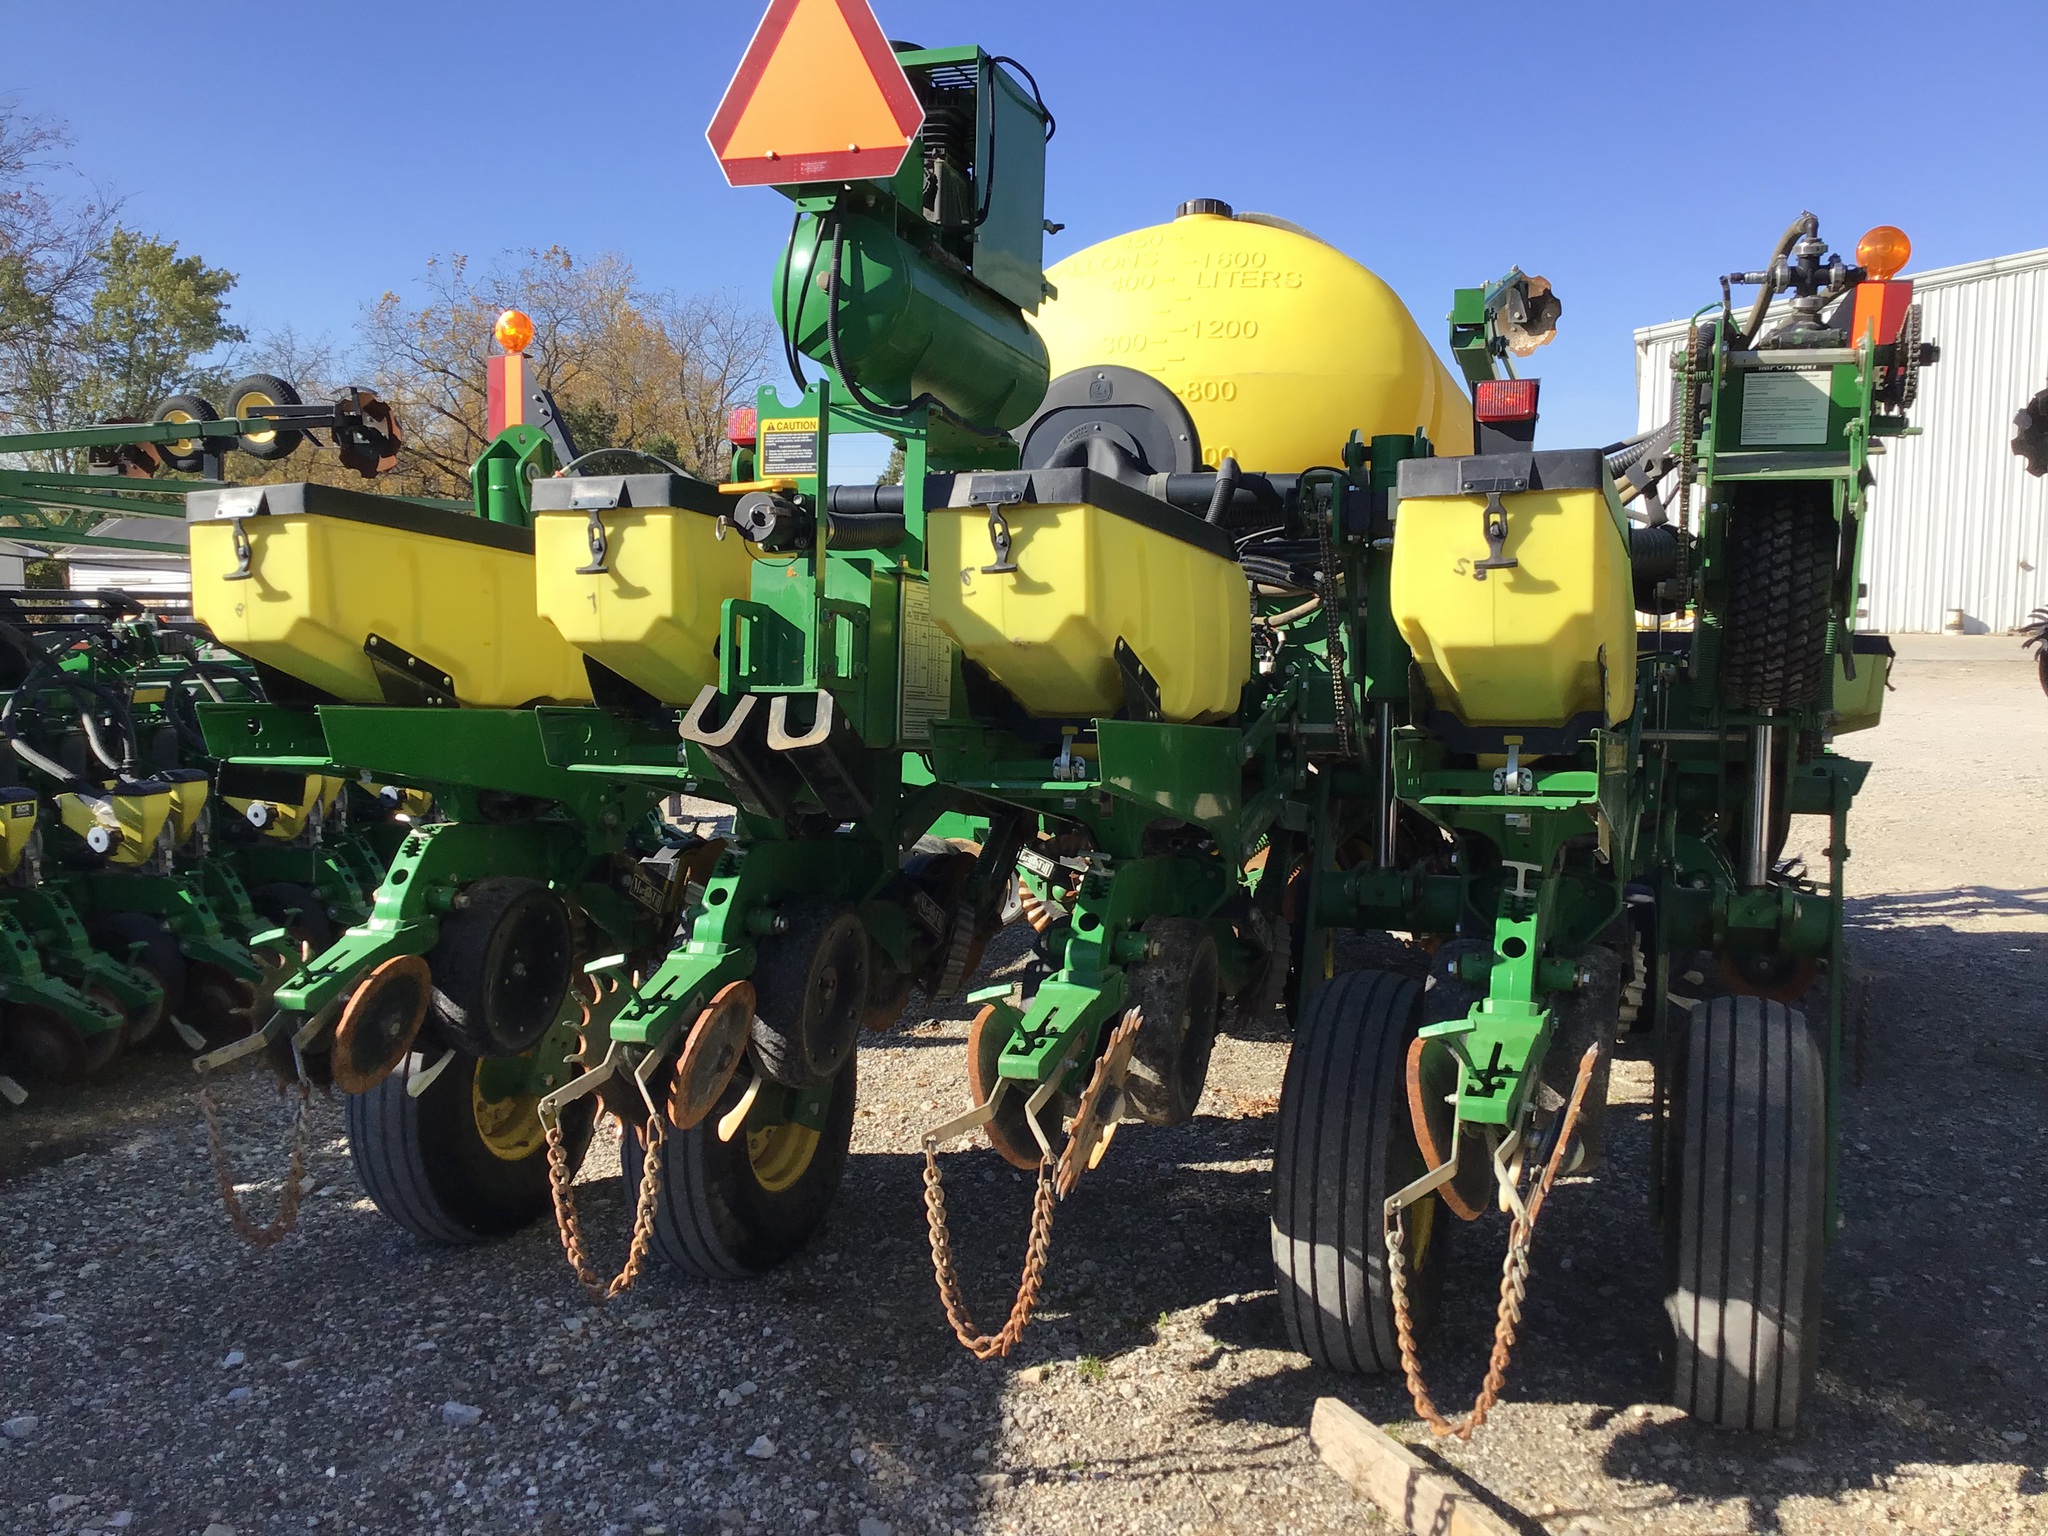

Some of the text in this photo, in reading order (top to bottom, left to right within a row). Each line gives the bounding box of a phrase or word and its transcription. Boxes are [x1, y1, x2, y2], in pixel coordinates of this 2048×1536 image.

[1201, 251, 1267, 269] 1600
[1196, 270, 1303, 289] LITERS
[1191, 319, 1259, 339] 1200
[1102, 333, 1147, 354] 300
[1187, 380, 1237, 402] 800
[776, 421, 816, 431] CAUTION
[1203, 446, 1238, 468] 00
